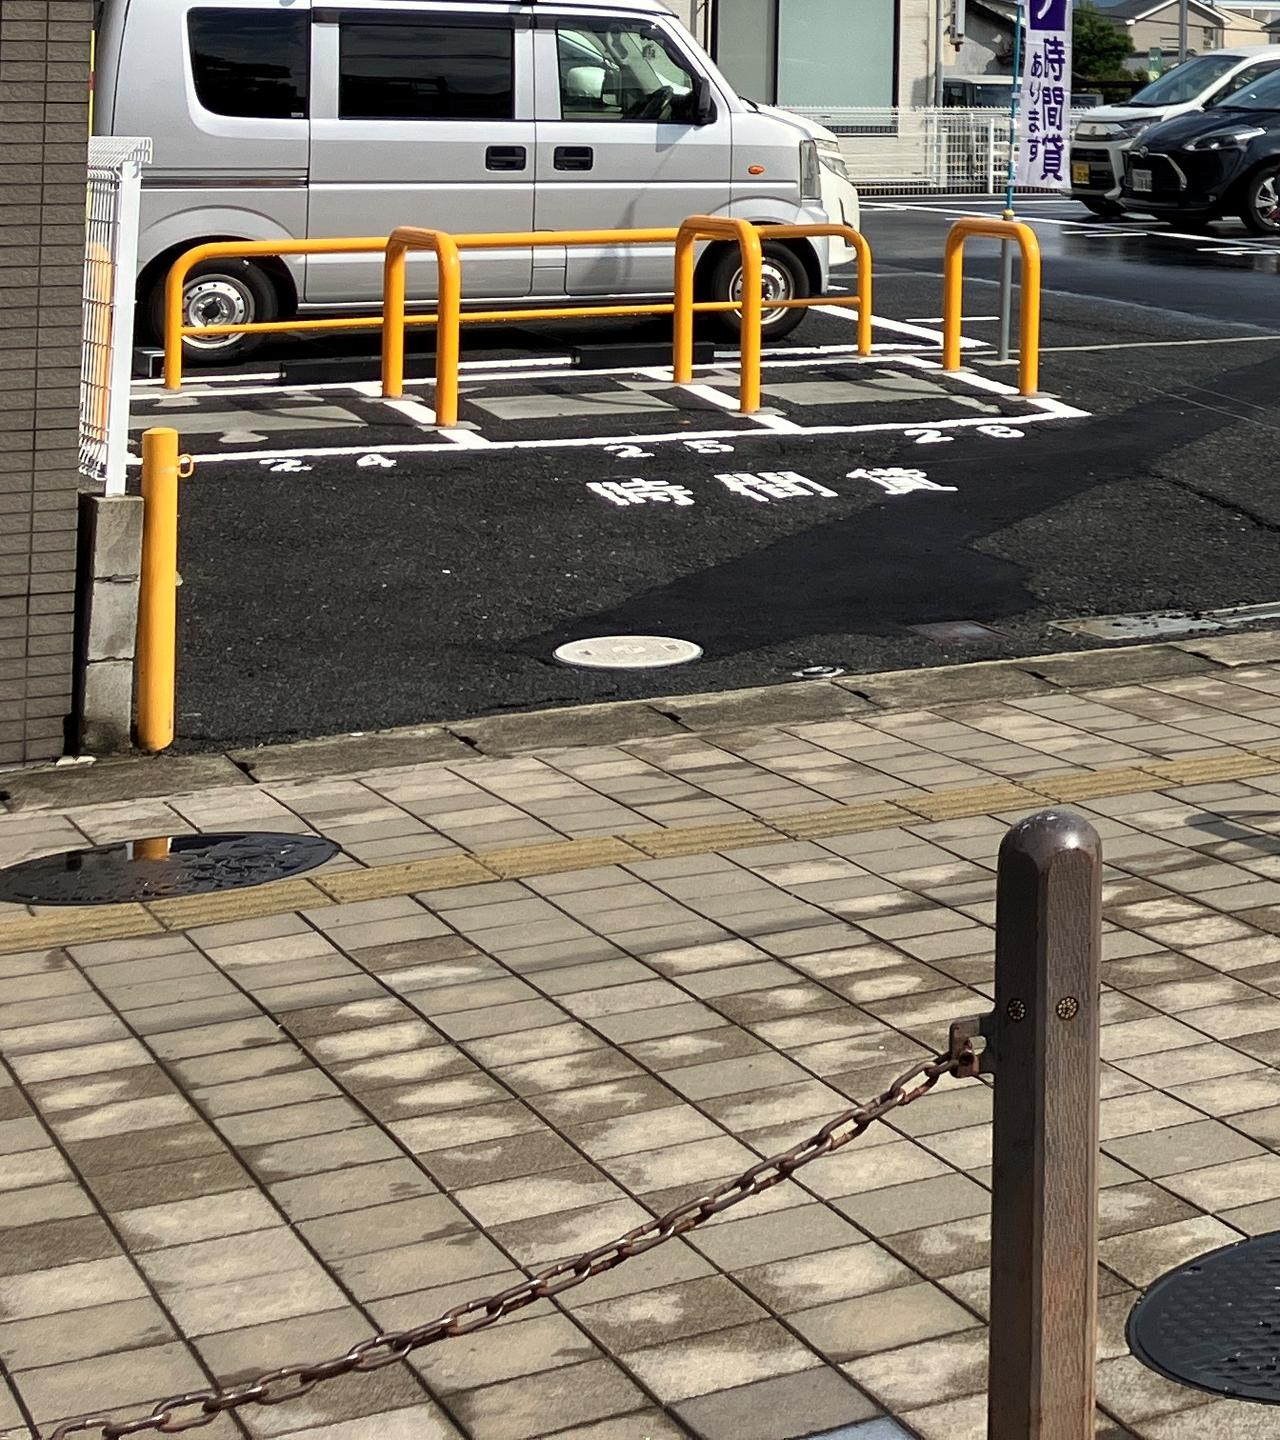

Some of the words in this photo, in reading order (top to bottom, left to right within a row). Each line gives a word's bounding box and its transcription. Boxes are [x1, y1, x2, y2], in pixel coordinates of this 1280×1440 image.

[1027, 50, 1043, 164] あります
[1041, 35, 1067, 182] 時間貸
[586, 467, 960, 506] 時間貸
